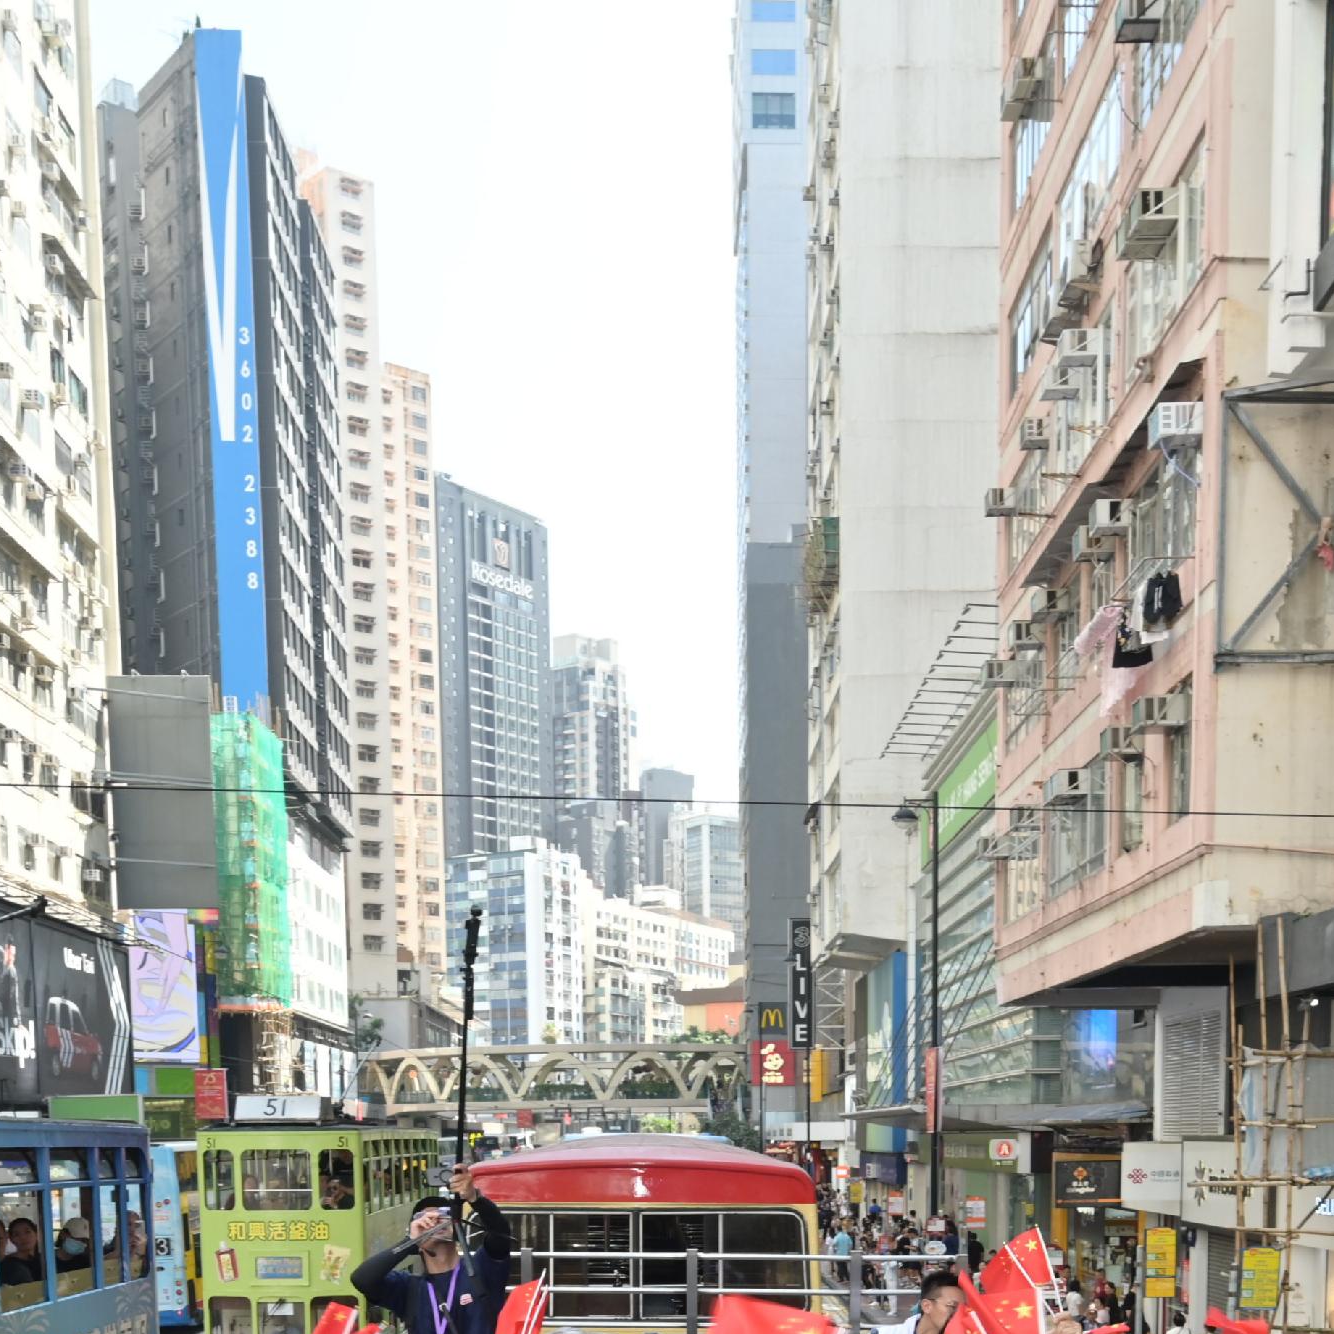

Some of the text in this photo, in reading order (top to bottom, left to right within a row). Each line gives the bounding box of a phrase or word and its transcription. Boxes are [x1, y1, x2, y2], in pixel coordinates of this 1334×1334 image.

[470, 561, 534, 600] Rosedale
[794, 953, 809, 1042] LIVE
[263, 1098, 287, 1117] 51
[206, 1138, 217, 1149] 51
[337, 1137, 349, 1148] 51
[228, 1220, 331, 1242] 和興活絡油
